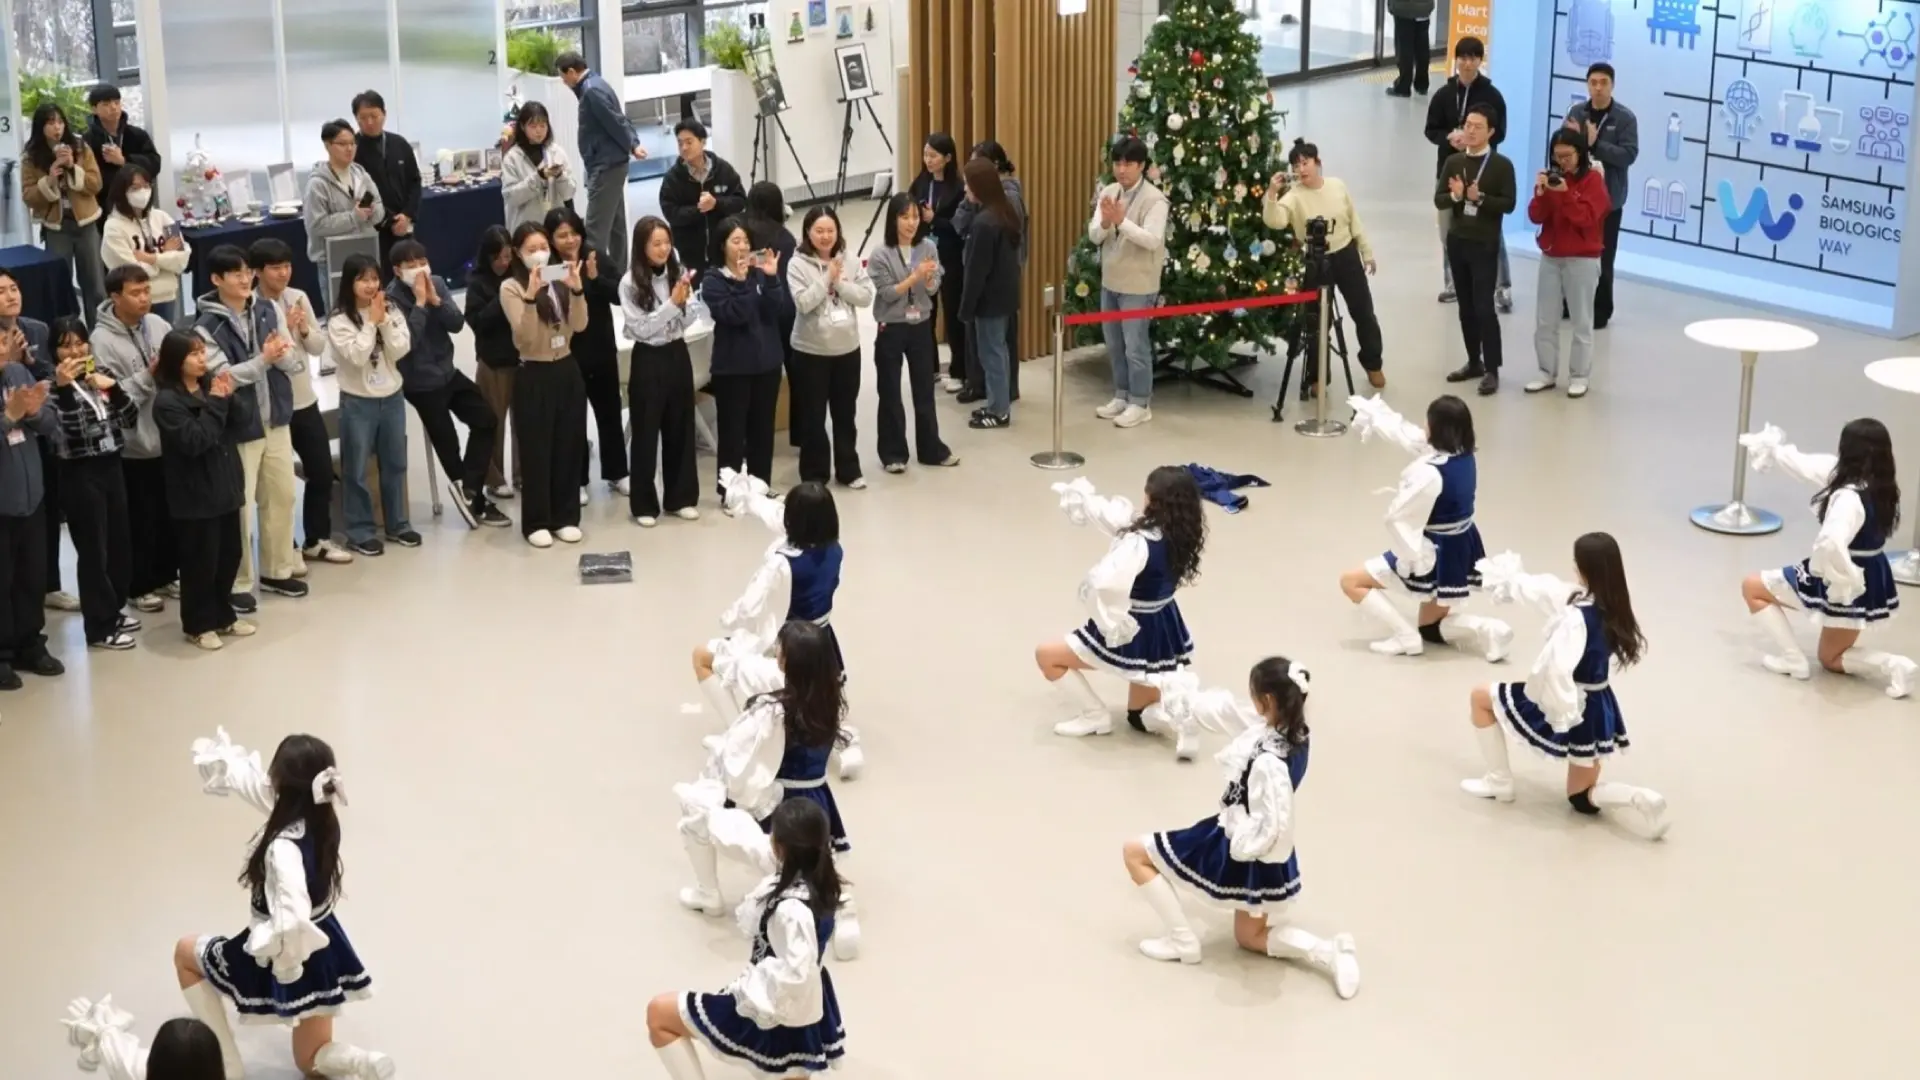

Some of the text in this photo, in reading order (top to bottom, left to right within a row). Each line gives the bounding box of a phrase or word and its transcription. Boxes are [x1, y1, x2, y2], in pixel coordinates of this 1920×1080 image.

[1457, 3, 1488, 18] Mart
[488, 50, 496, 65] 2
[0, 116, 10, 133] 3
[1821, 194, 1896, 221] SAMSUNG
[1819, 215, 1902, 243] BIOLOGICS
[1818, 237, 1852, 257] WAY
